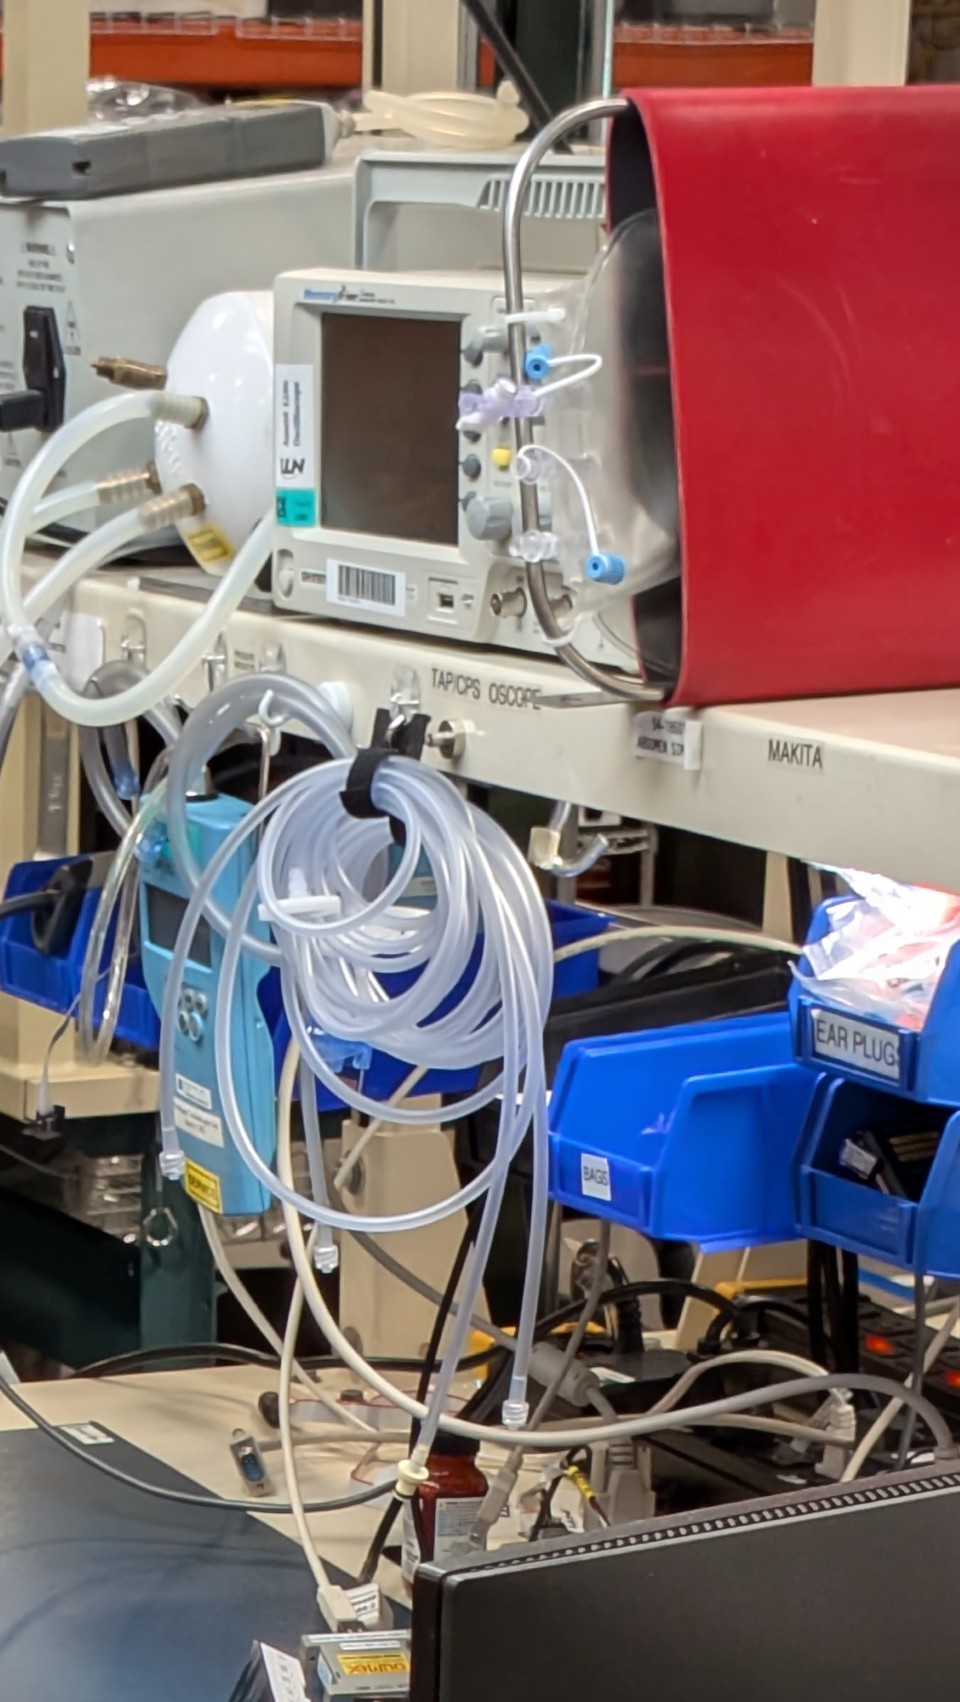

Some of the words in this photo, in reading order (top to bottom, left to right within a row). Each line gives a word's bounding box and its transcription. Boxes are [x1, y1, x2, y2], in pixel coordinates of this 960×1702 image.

[768, 738, 824, 770] MAKITA
[815, 1019, 849, 1051] EAR
[852, 1031, 899, 1067] PLUG
[583, 1165, 609, 1187] BAGS
